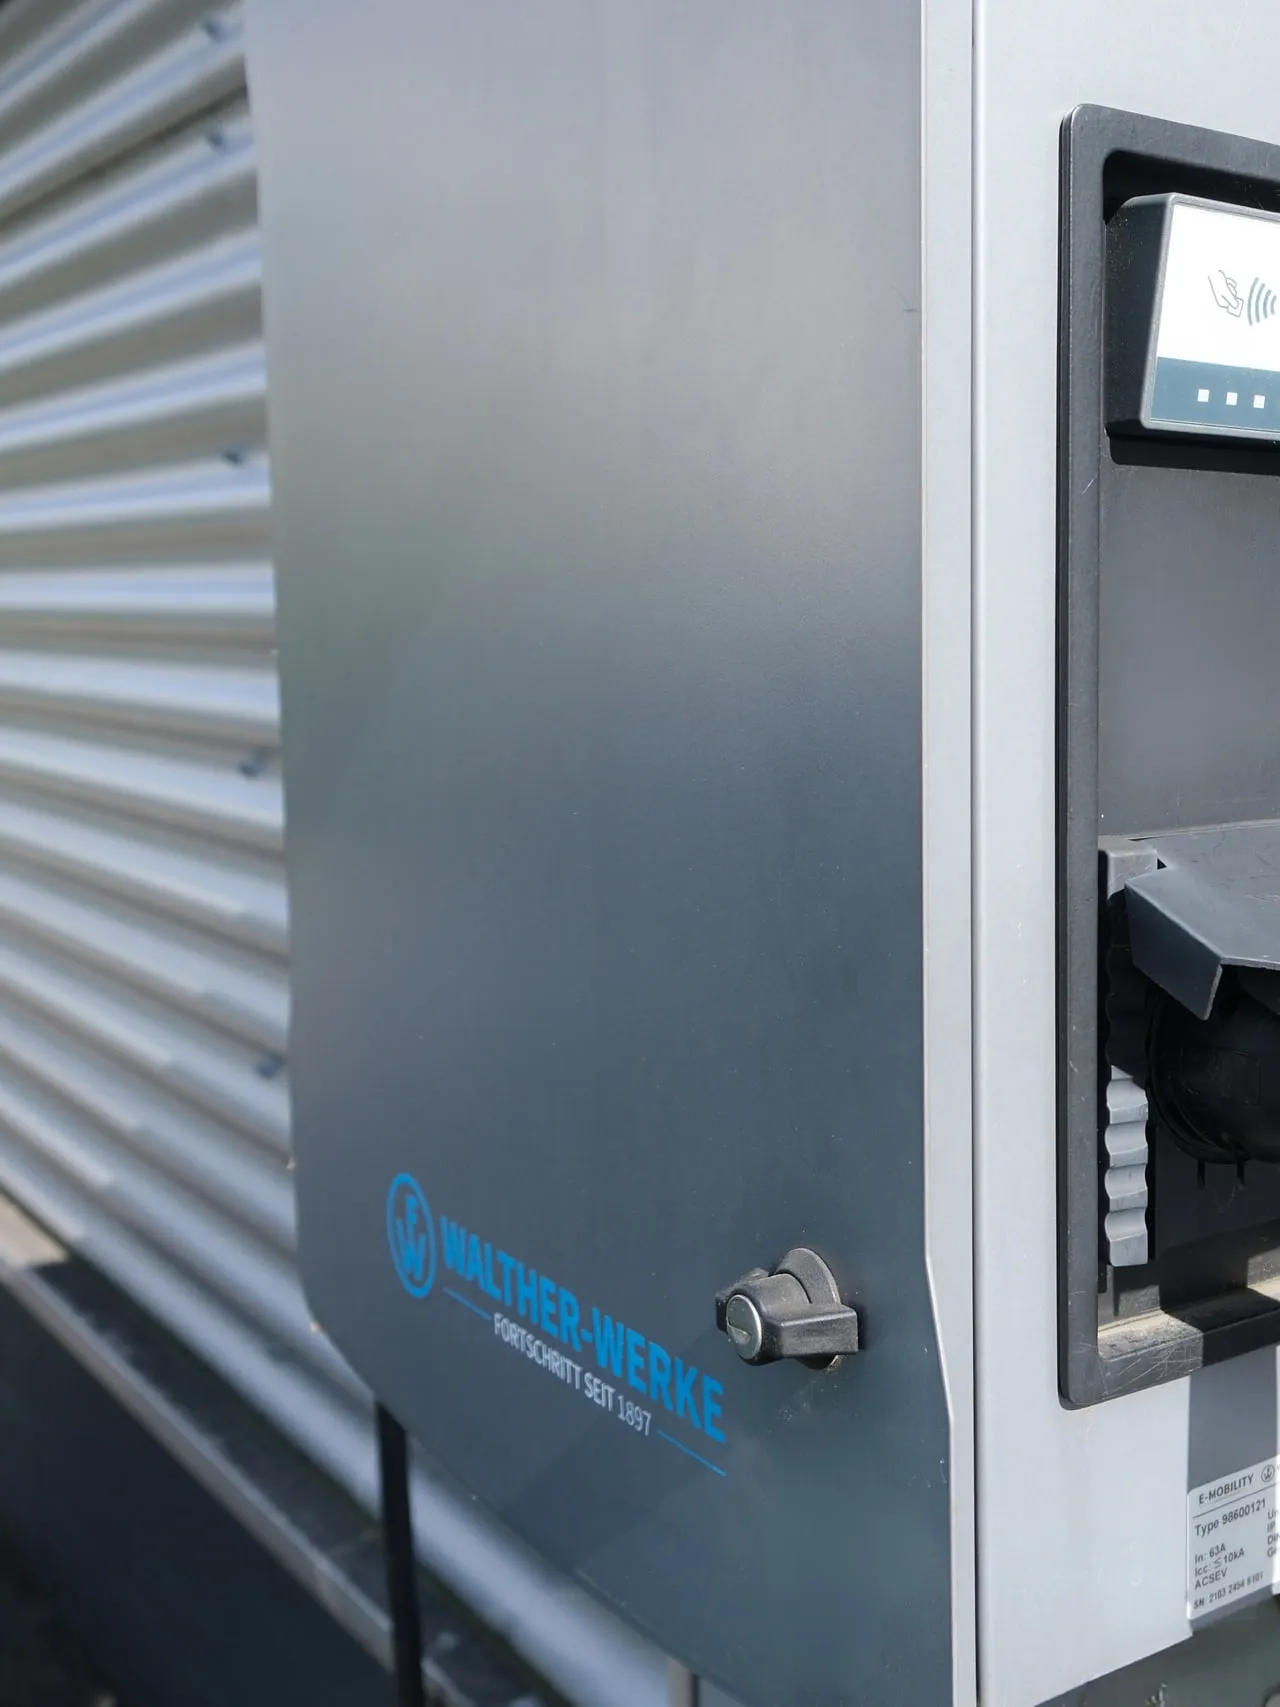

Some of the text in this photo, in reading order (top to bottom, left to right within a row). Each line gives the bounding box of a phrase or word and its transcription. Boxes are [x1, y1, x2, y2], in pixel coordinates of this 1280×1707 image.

[440, 1214, 726, 1443] WALTHER-WERKE
[494, 1312, 652, 1436] FORTSCHRITT SEIT 1897
[1199, 1473, 1254, 1504] E-MOBILITY
[1195, 1498, 1266, 1537] Type 98600121
[1209, 1543, 1226, 1558] 63A
[1194, 1567, 1228, 1590] ACSEV
